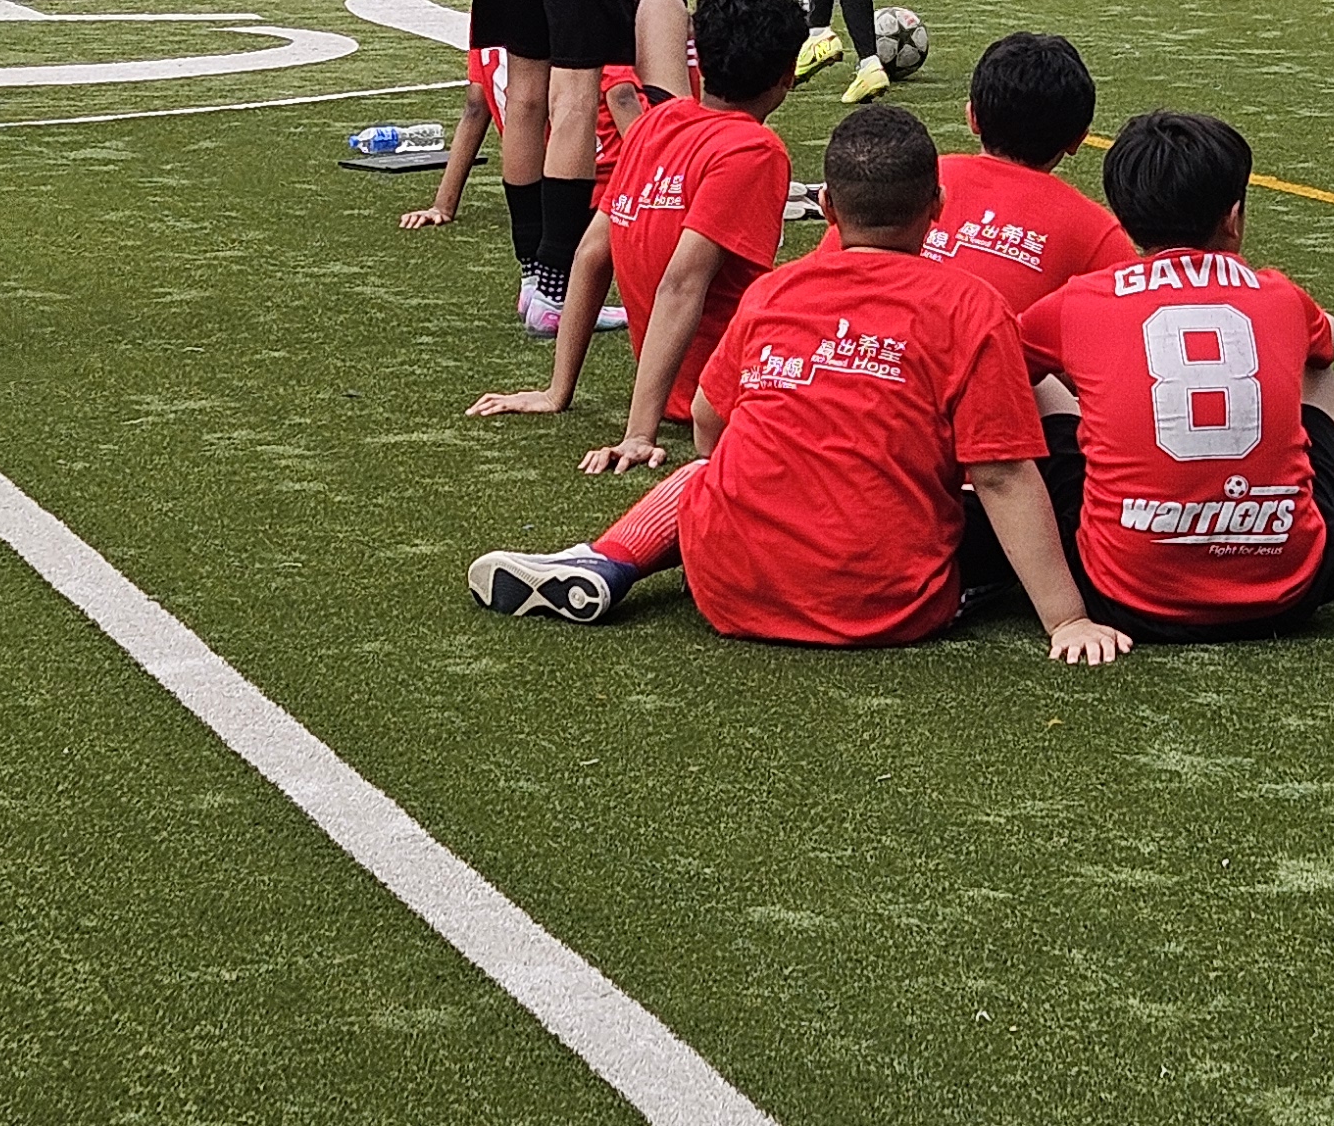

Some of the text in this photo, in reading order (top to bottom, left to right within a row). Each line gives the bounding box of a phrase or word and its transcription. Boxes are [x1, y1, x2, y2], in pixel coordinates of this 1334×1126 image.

[995, 240, 1041, 266] Hope
[1114, 253, 1261, 297] GAVIN
[853, 357, 902, 377] Hope
[1142, 303, 1262, 462] 8
[1121, 499, 1296, 534] warriors
[1208, 544, 1237, 557] Fight
[1238, 545, 1254, 555] for
